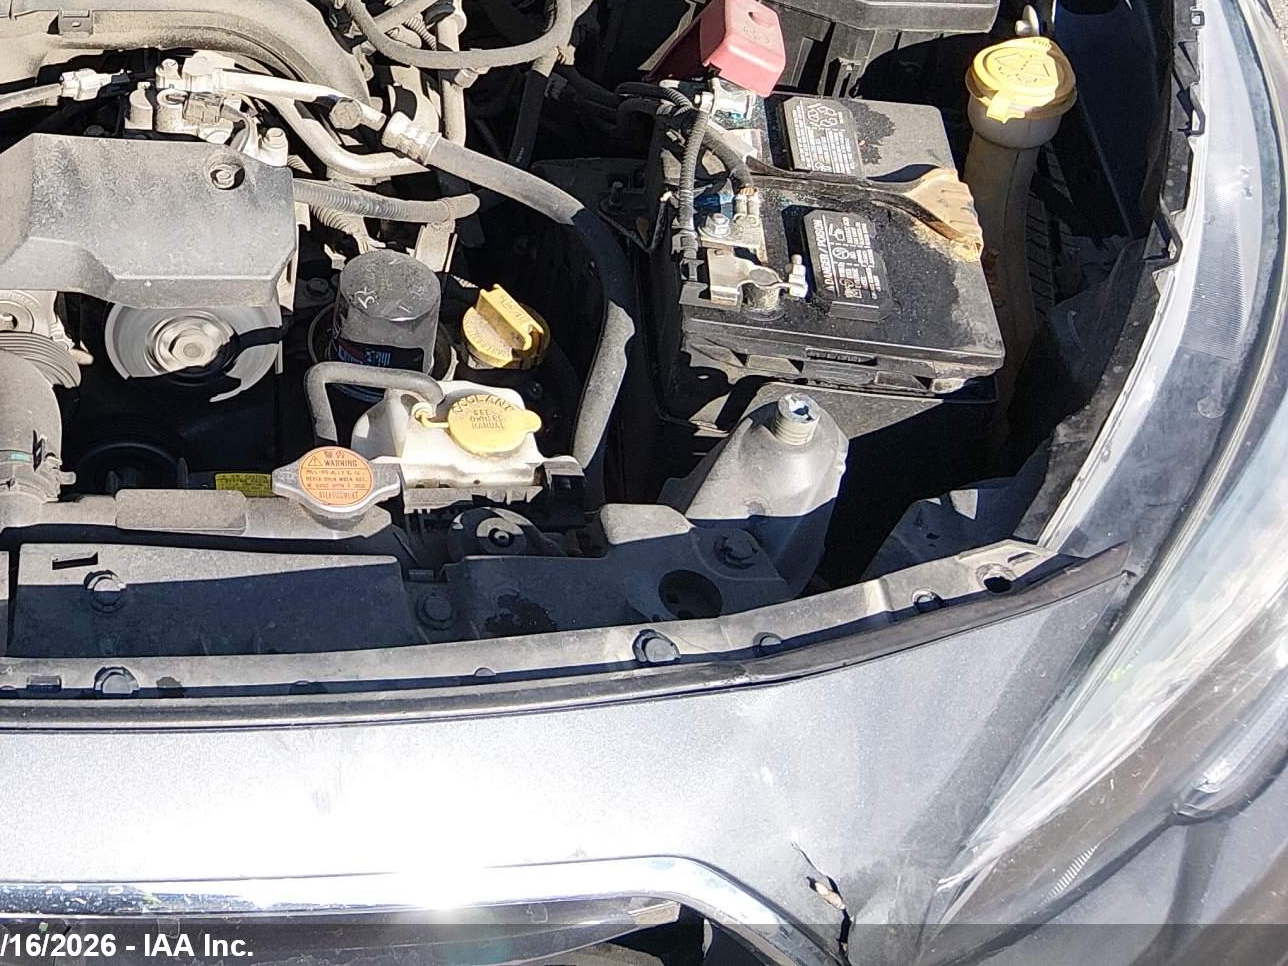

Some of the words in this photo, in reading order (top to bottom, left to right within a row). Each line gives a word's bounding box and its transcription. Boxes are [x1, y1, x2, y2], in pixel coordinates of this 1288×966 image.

[813, 219, 827, 246] POISON
[819, 253, 834, 285] DANGER
[453, 394, 513, 413] COOLANT
[324, 459, 358, 467] WARNING
